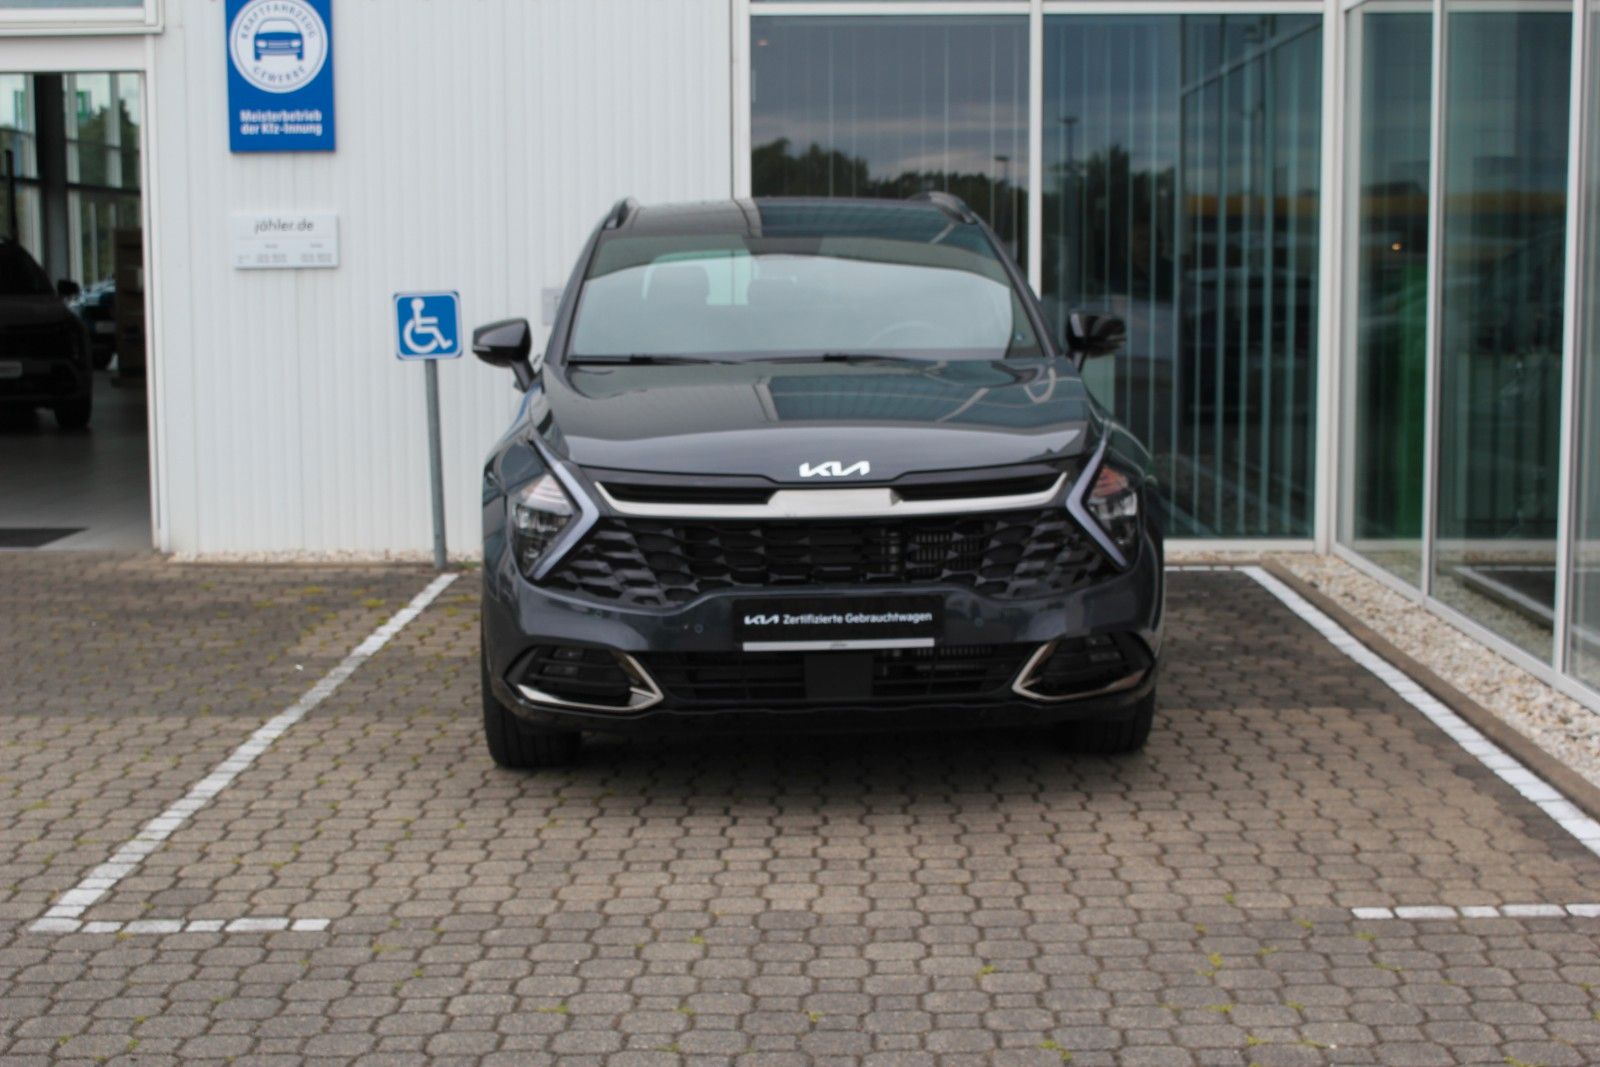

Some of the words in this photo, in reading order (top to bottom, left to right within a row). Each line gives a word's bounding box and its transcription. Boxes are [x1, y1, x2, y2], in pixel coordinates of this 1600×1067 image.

[253, 64, 306, 82] GEWERBE
[240, 109, 322, 122] Meisterbetrieb
[240, 123, 259, 135] der
[261, 123, 323, 136] Kfz-Innung
[782, 613, 843, 625] Zertifizierte
[844, 612, 933, 624] Gebrauchtwagen
